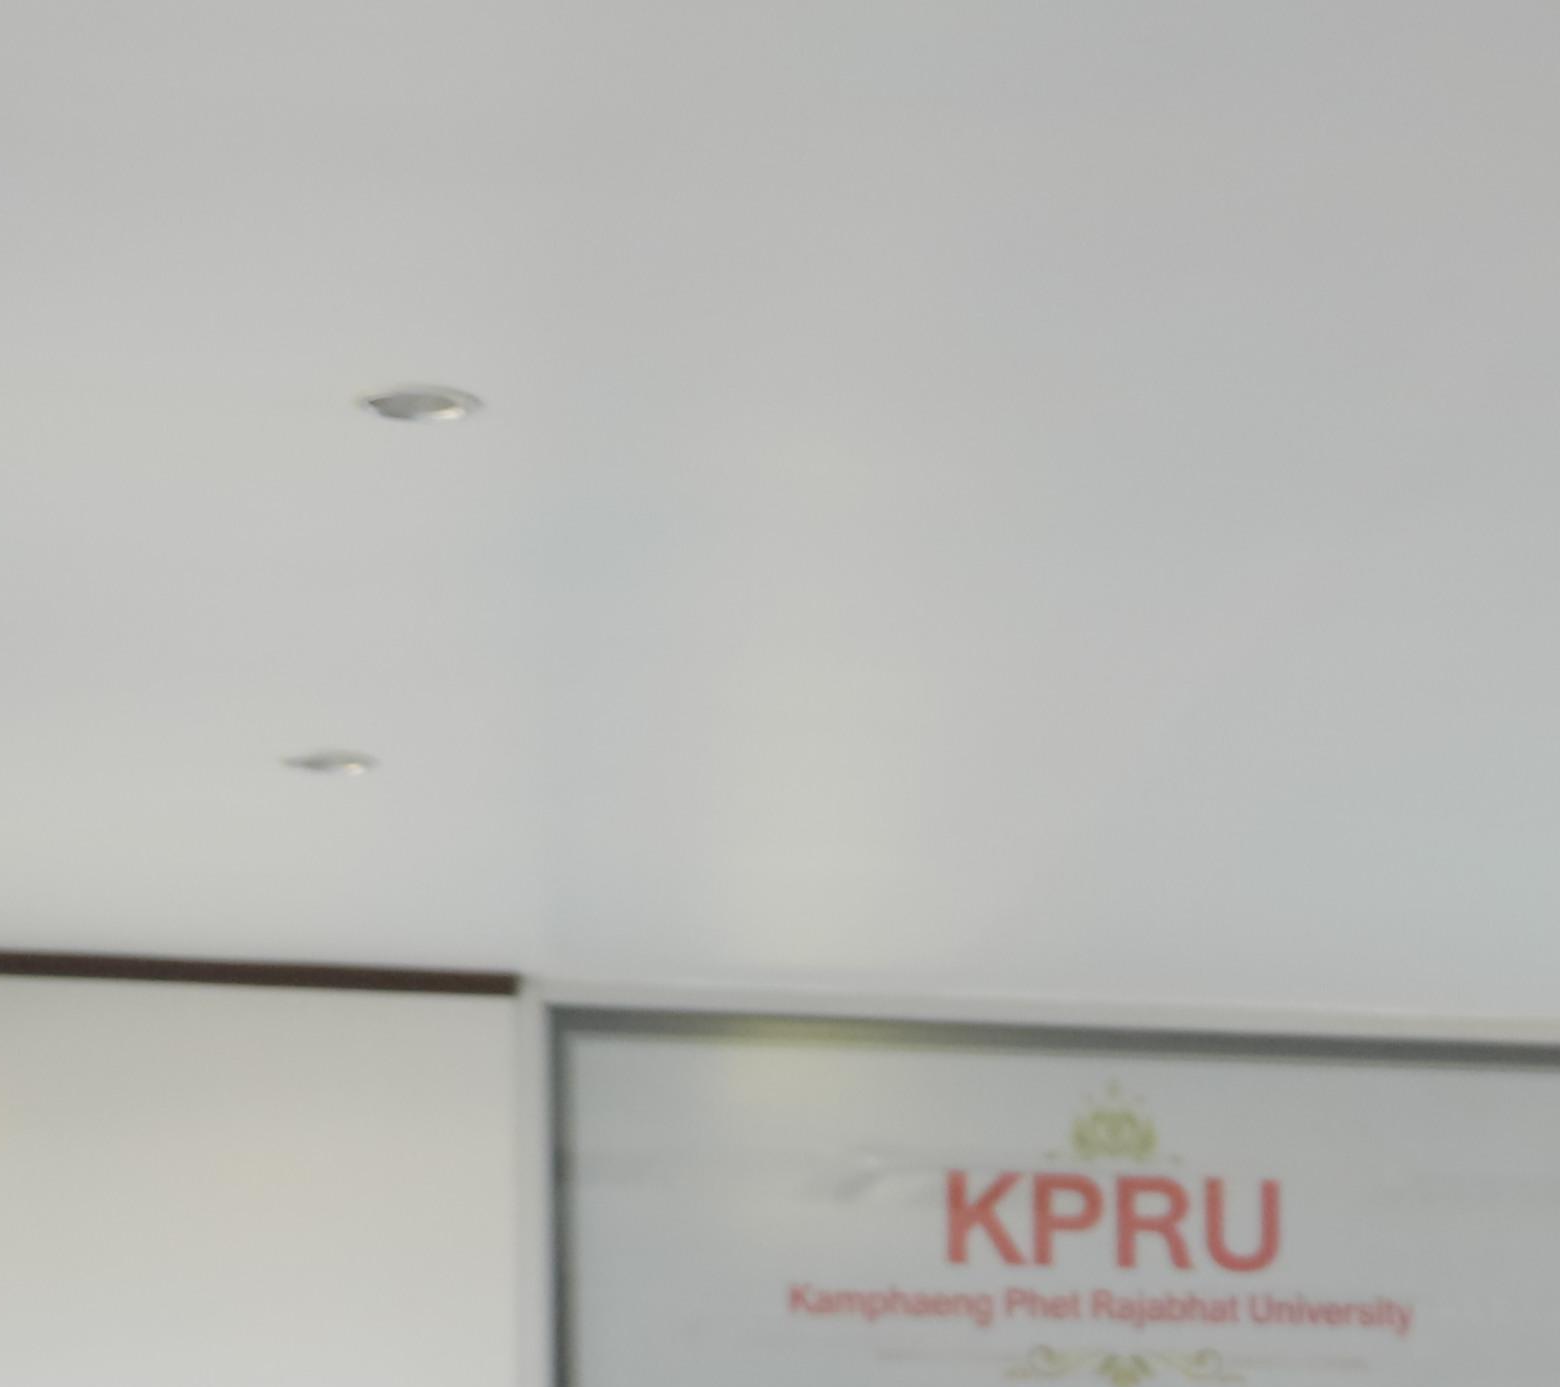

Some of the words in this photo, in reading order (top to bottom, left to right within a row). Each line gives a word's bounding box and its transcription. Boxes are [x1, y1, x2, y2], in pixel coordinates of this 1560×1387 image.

[946, 1170, 1281, 1273] KPRU
[788, 1283, 993, 1329] Kamphaeng
[1003, 1287, 1082, 1319] Phet
[1091, 1289, 1240, 1331] Rajabhat
[1248, 1293, 1412, 1341] University
